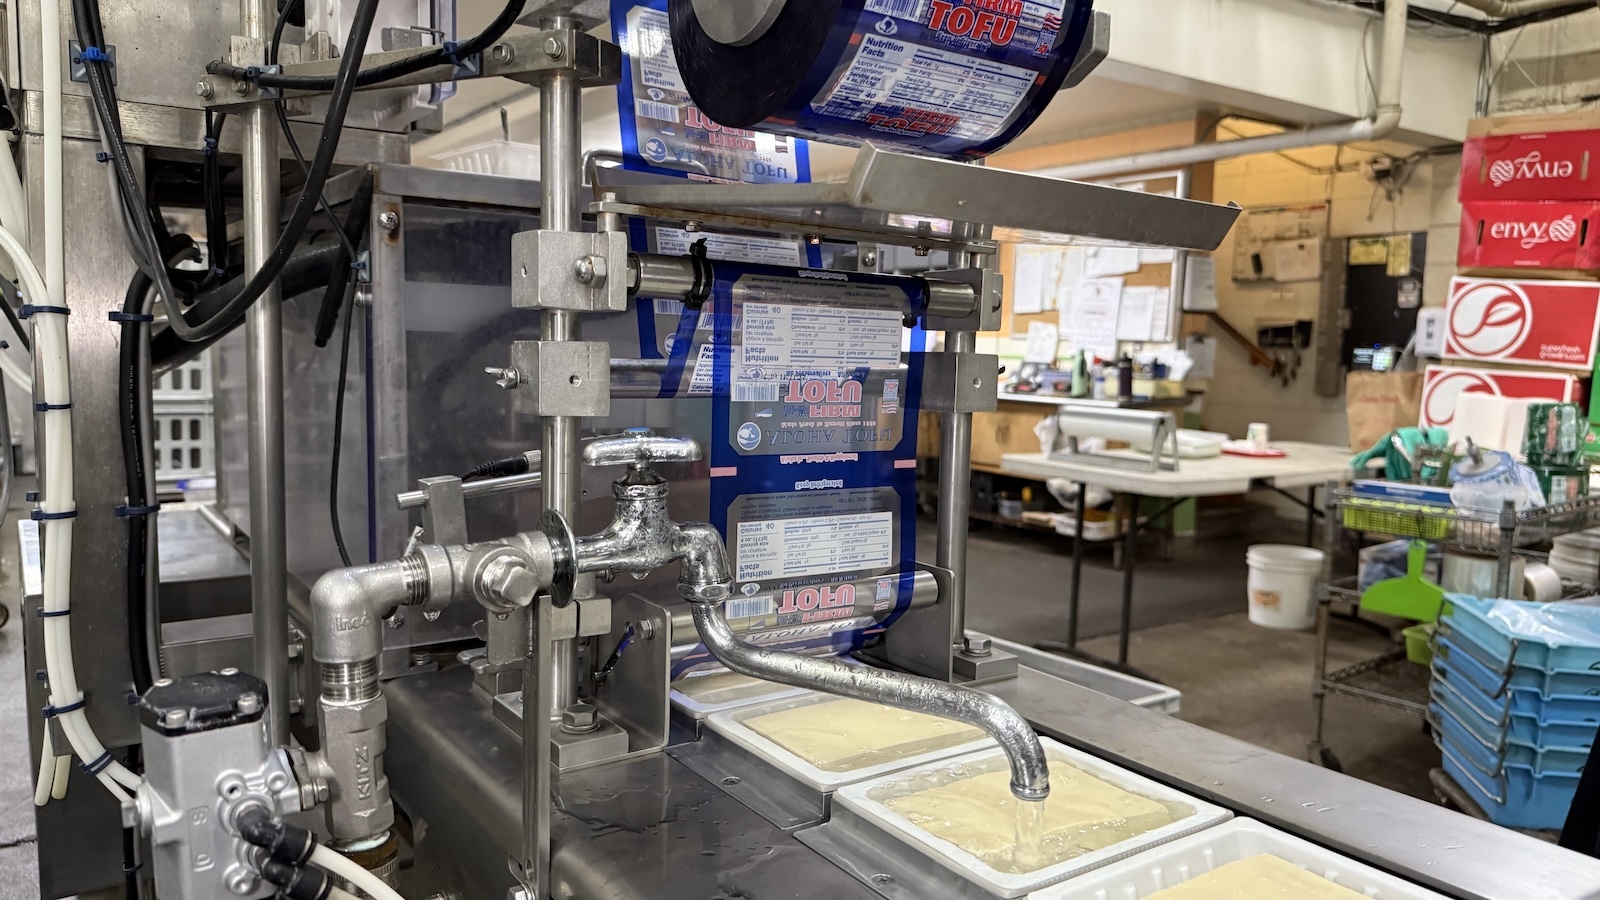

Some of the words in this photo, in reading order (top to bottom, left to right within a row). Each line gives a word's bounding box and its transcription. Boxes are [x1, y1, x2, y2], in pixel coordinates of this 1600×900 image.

[929, 0, 1019, 46] TOFU
[866, 36, 904, 52] Nutrition
[861, 46, 886, 58] Facts
[856, 60, 874, 68] Approx
[850, 71, 869, 79] Serving
[840, 85, 864, 93] Calories
[1513, 151, 1573, 179] envy
[1490, 221, 1550, 249] envy
[703, 346, 736, 354] Nutrition
[355, 745, 371, 800] KITZ
